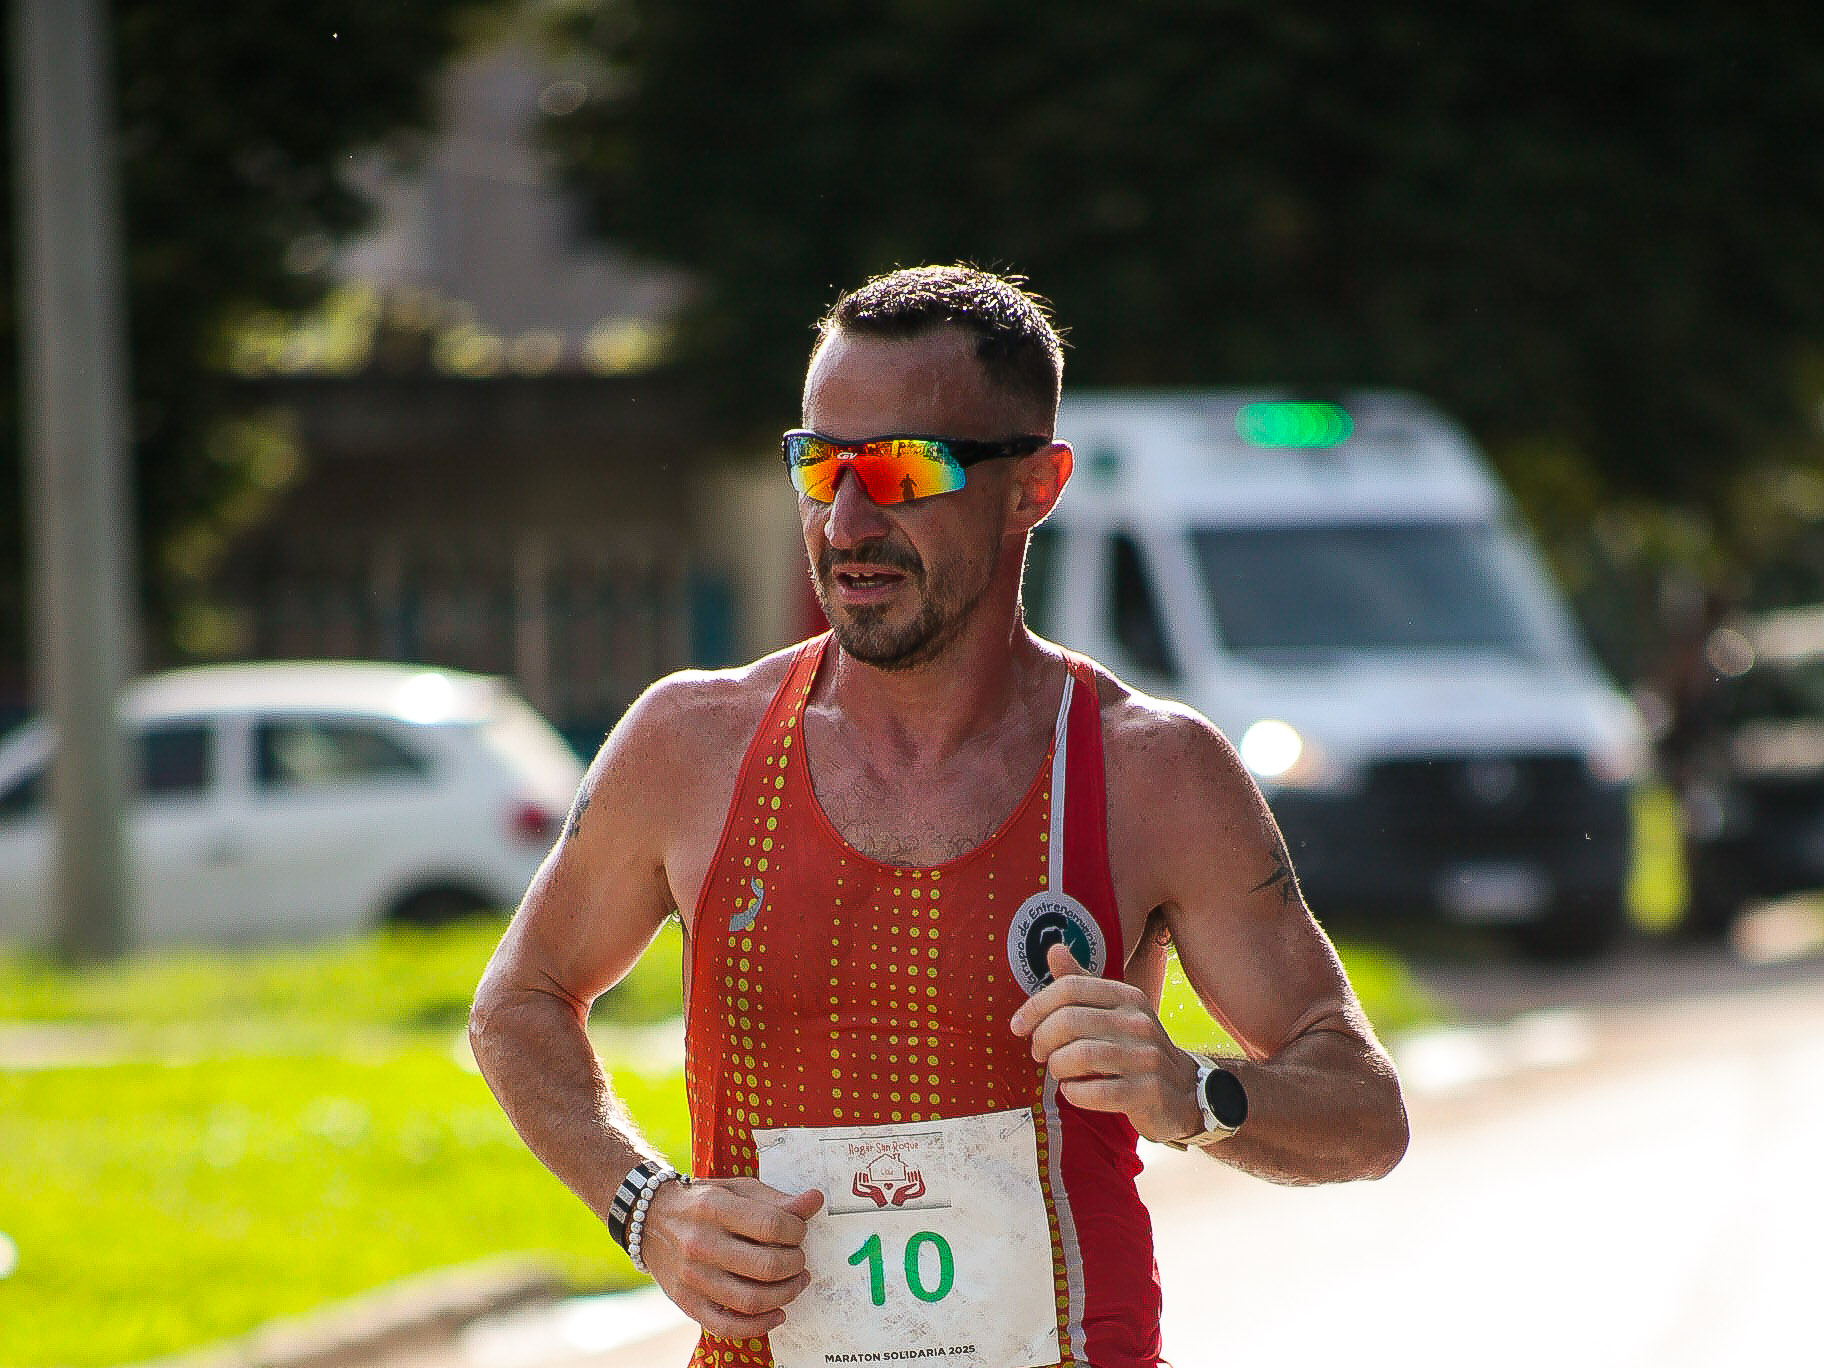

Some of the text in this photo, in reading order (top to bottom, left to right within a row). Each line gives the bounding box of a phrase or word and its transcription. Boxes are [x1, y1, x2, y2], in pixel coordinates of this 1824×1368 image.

[1018, 920, 1030, 937] de
[848, 1231, 954, 1306] 10
[825, 1345, 976, 1364] MARATON SOLIDARIA 2025
